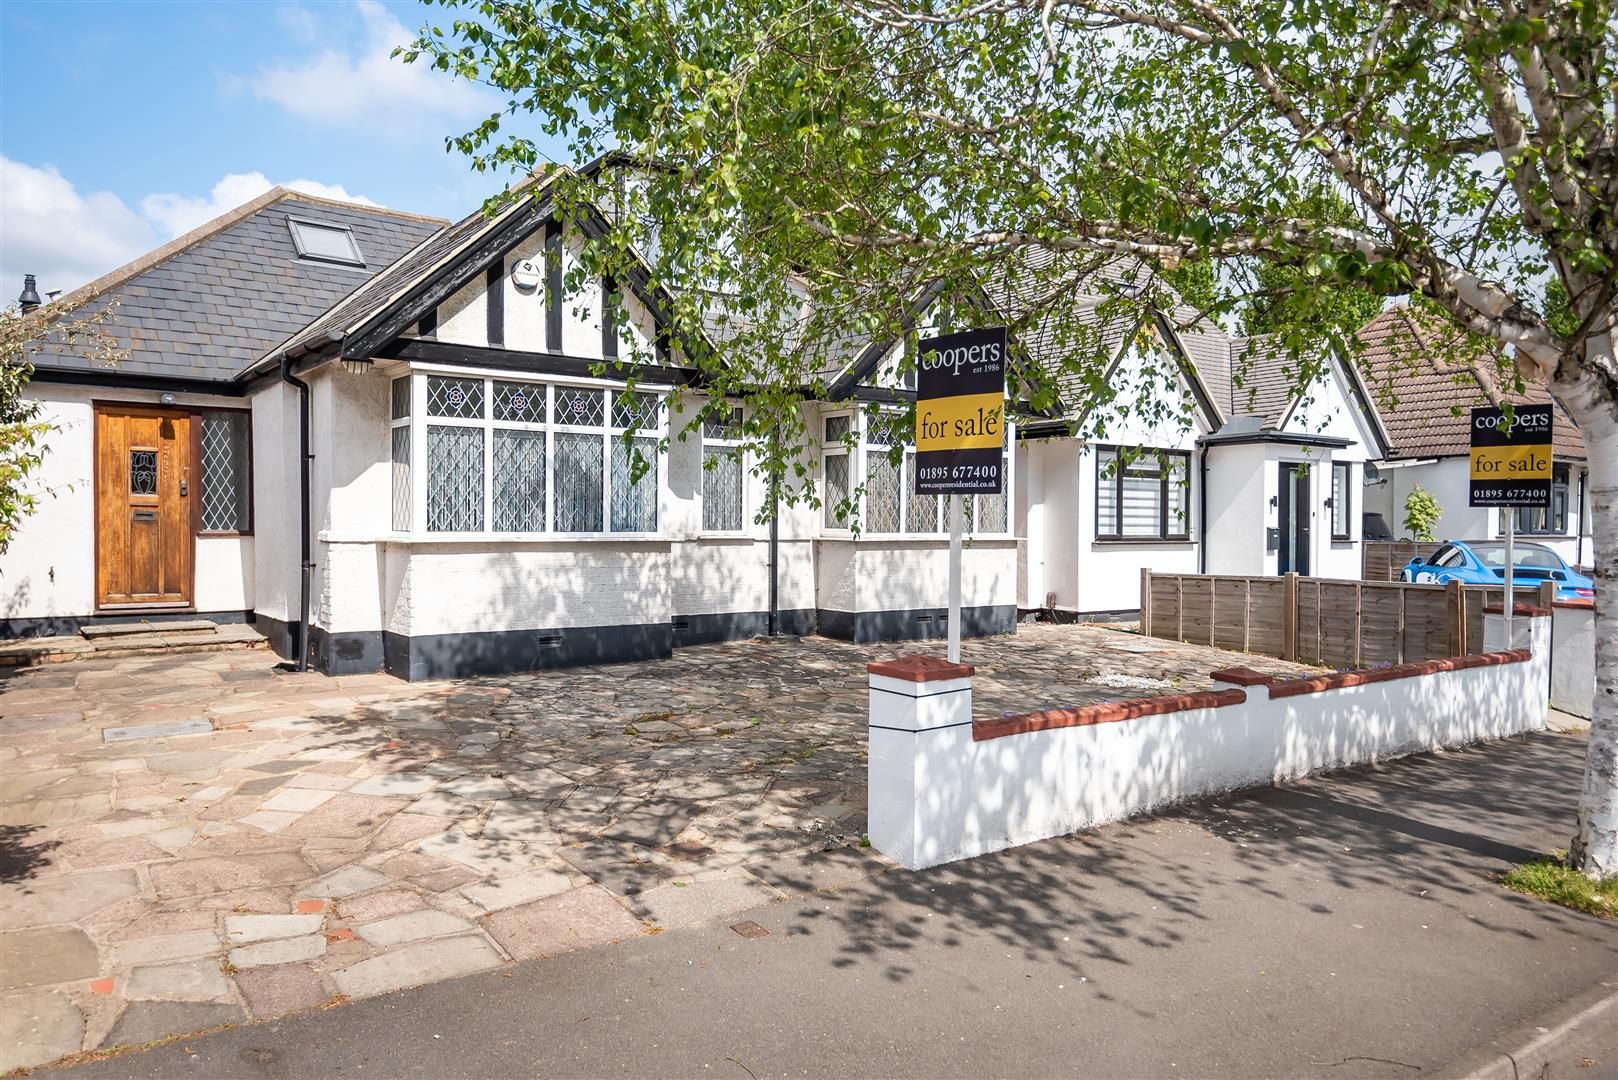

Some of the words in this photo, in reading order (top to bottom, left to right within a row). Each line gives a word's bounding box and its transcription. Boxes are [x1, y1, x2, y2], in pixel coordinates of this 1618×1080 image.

[972, 366, 982, 374] est
[984, 363, 1000, 373] 1986
[921, 411, 948, 440] for
[954, 408, 998, 437] sale
[1475, 454, 1502, 473] for
[1508, 453, 1547, 472] sale
[920, 466, 948, 479] 01895
[952, 465, 997, 479] 677400
[1473, 489, 1503, 498] 01895
[1506, 489, 1547, 498] 677400
